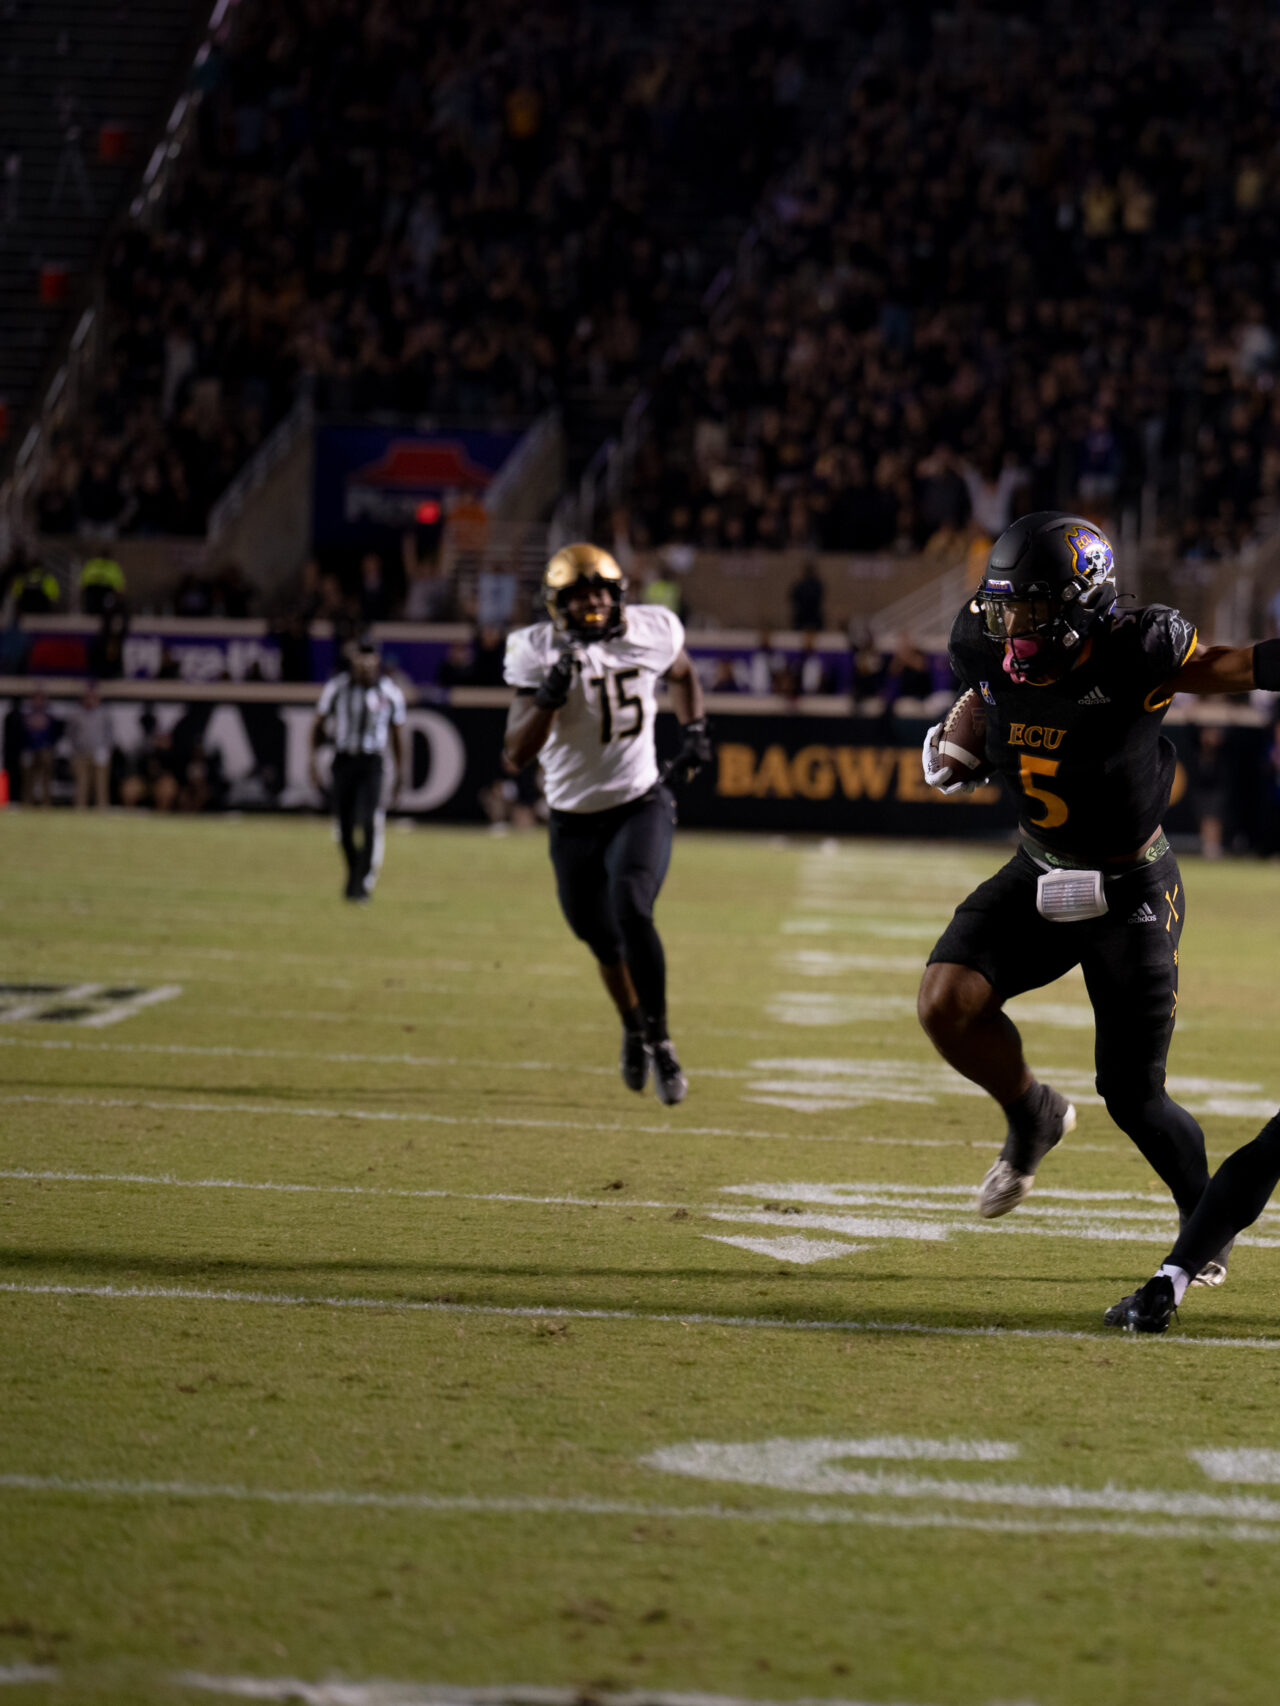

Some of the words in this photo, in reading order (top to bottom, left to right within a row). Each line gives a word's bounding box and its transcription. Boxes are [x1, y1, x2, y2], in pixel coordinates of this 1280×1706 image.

[590, 669, 643, 743] 15
[1007, 722, 1068, 750] ECU
[1018, 751, 1070, 829] 5
